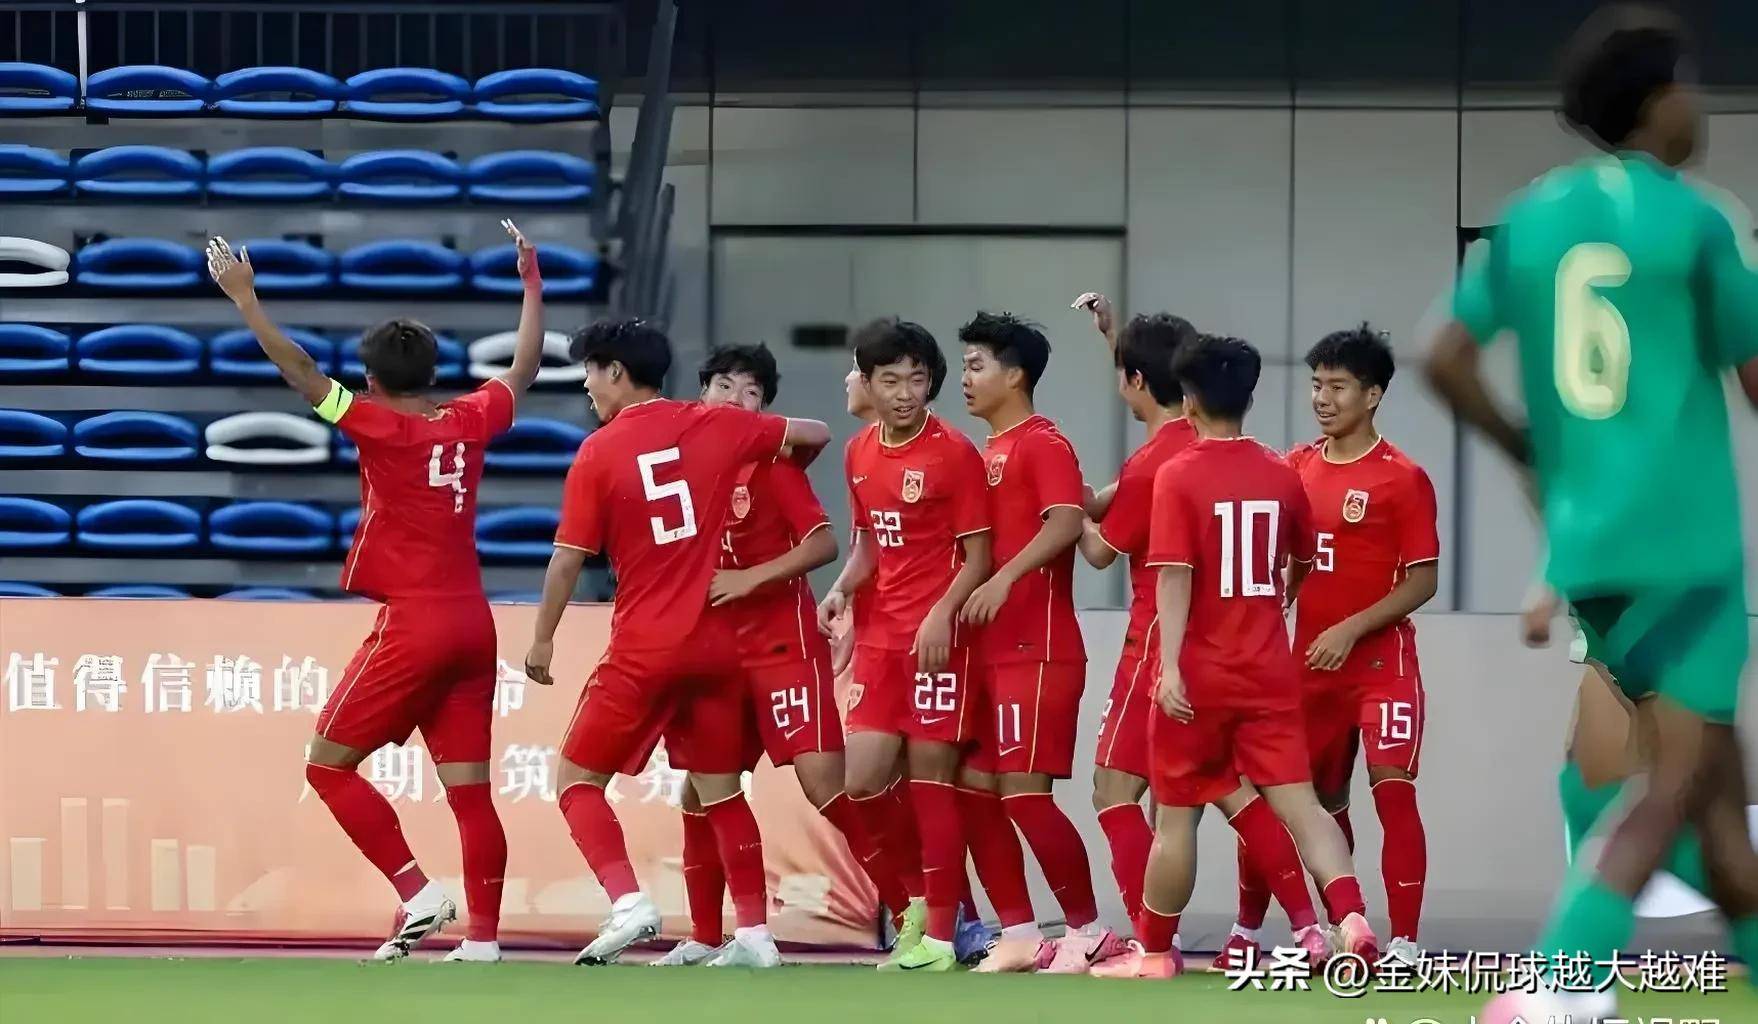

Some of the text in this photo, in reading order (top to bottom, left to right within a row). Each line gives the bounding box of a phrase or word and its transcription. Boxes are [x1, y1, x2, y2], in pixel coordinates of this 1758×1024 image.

[1553, 242, 1632, 420] 6
[428, 442, 467, 513] 4
[636, 447, 698, 545] 5
[870, 510, 904, 547] 22
[1214, 500, 1280, 598] 10
[1315, 533, 1334, 572] 5
[771, 687, 809, 728] 24
[914, 672, 957, 711] 22
[998, 703, 1021, 743] 11
[1379, 702, 1412, 739] 15
